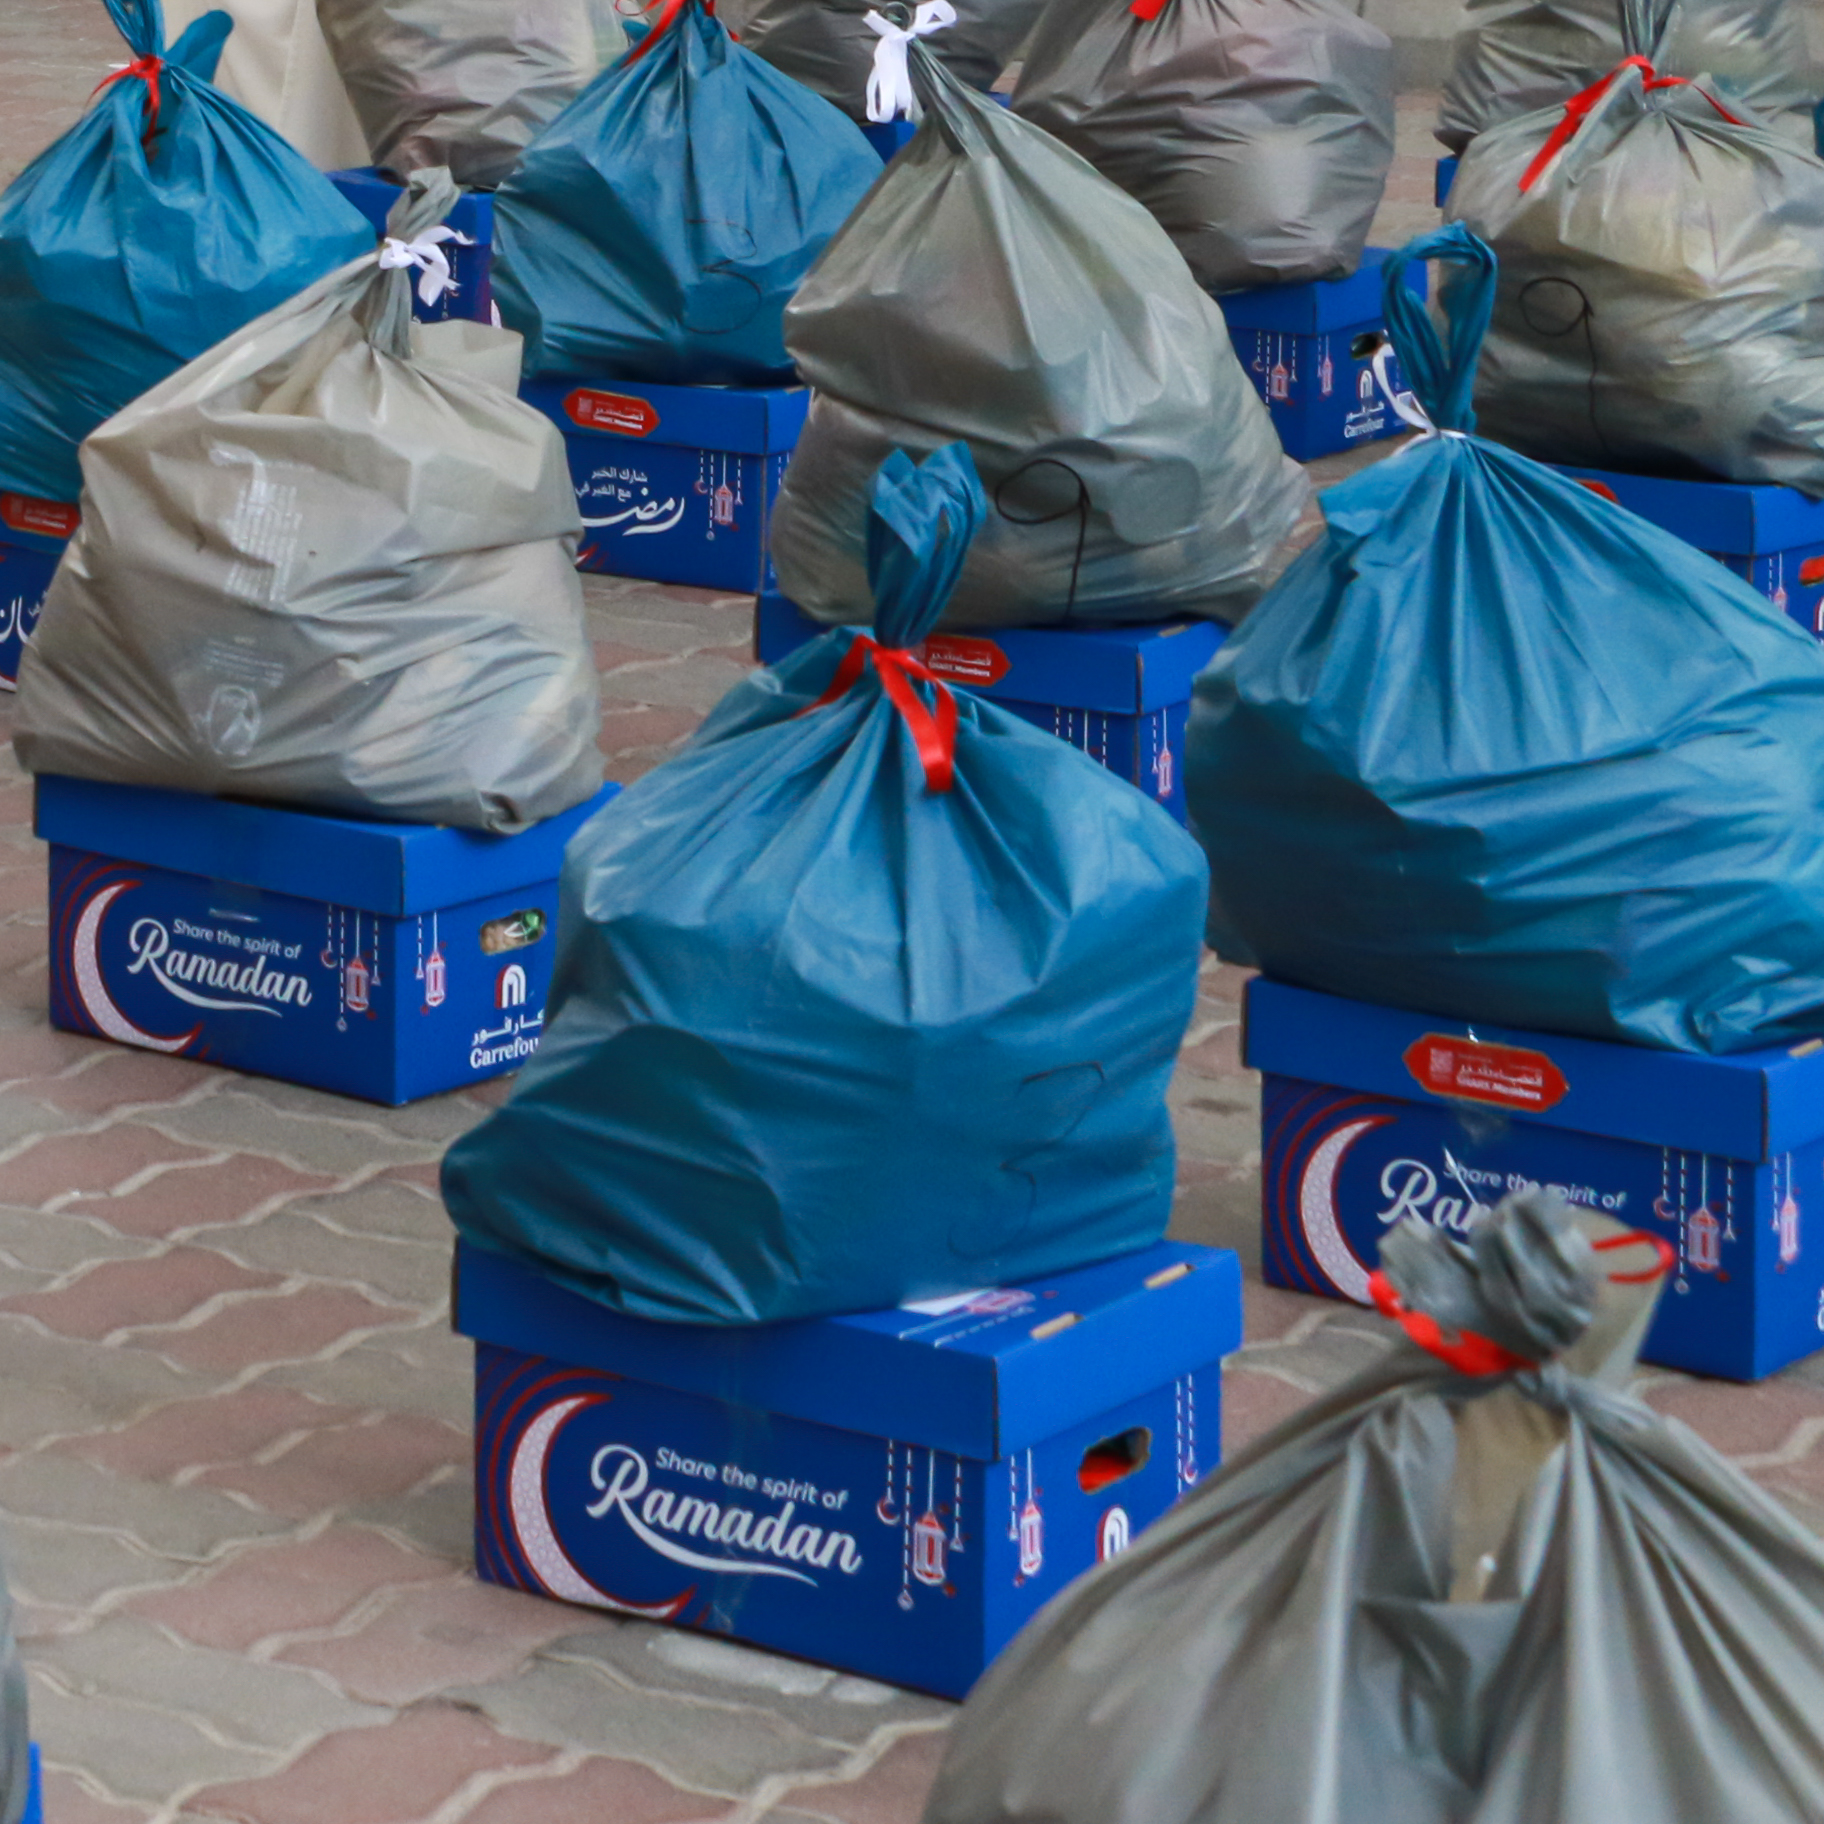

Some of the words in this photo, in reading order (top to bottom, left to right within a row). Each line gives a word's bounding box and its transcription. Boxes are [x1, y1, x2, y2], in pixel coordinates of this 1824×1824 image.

[127, 917, 312, 1012] Ramadan
[173, 918, 214, 942] Share
[217, 929, 241, 949] the
[243, 937, 281, 956] spirit
[284, 944, 302, 959] of
[1601, 1191, 1627, 1210] of
[655, 1446, 717, 1481] Share
[721, 1463, 758, 1490] the
[761, 1476, 817, 1505] spirit
[821, 1488, 850, 1511] of
[585, 1443, 864, 1584] Ramadan
